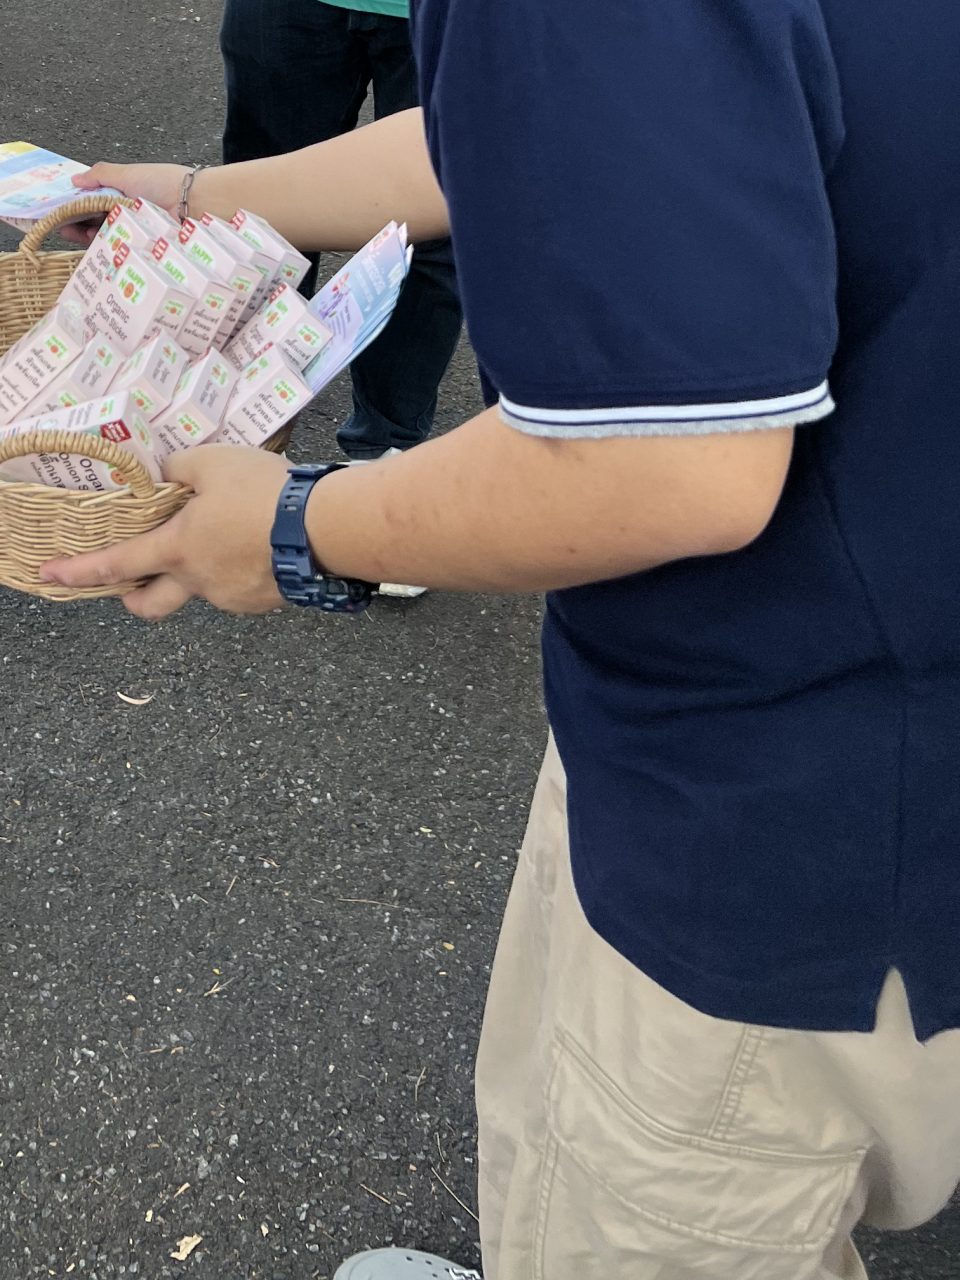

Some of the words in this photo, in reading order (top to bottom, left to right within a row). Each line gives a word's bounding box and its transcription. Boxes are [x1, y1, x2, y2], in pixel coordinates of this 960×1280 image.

[95, 302, 111, 323] Onion
[108, 316, 128, 341] Sticker
[106, 293, 130, 324] Organic
[59, 452, 81, 482] Onion
